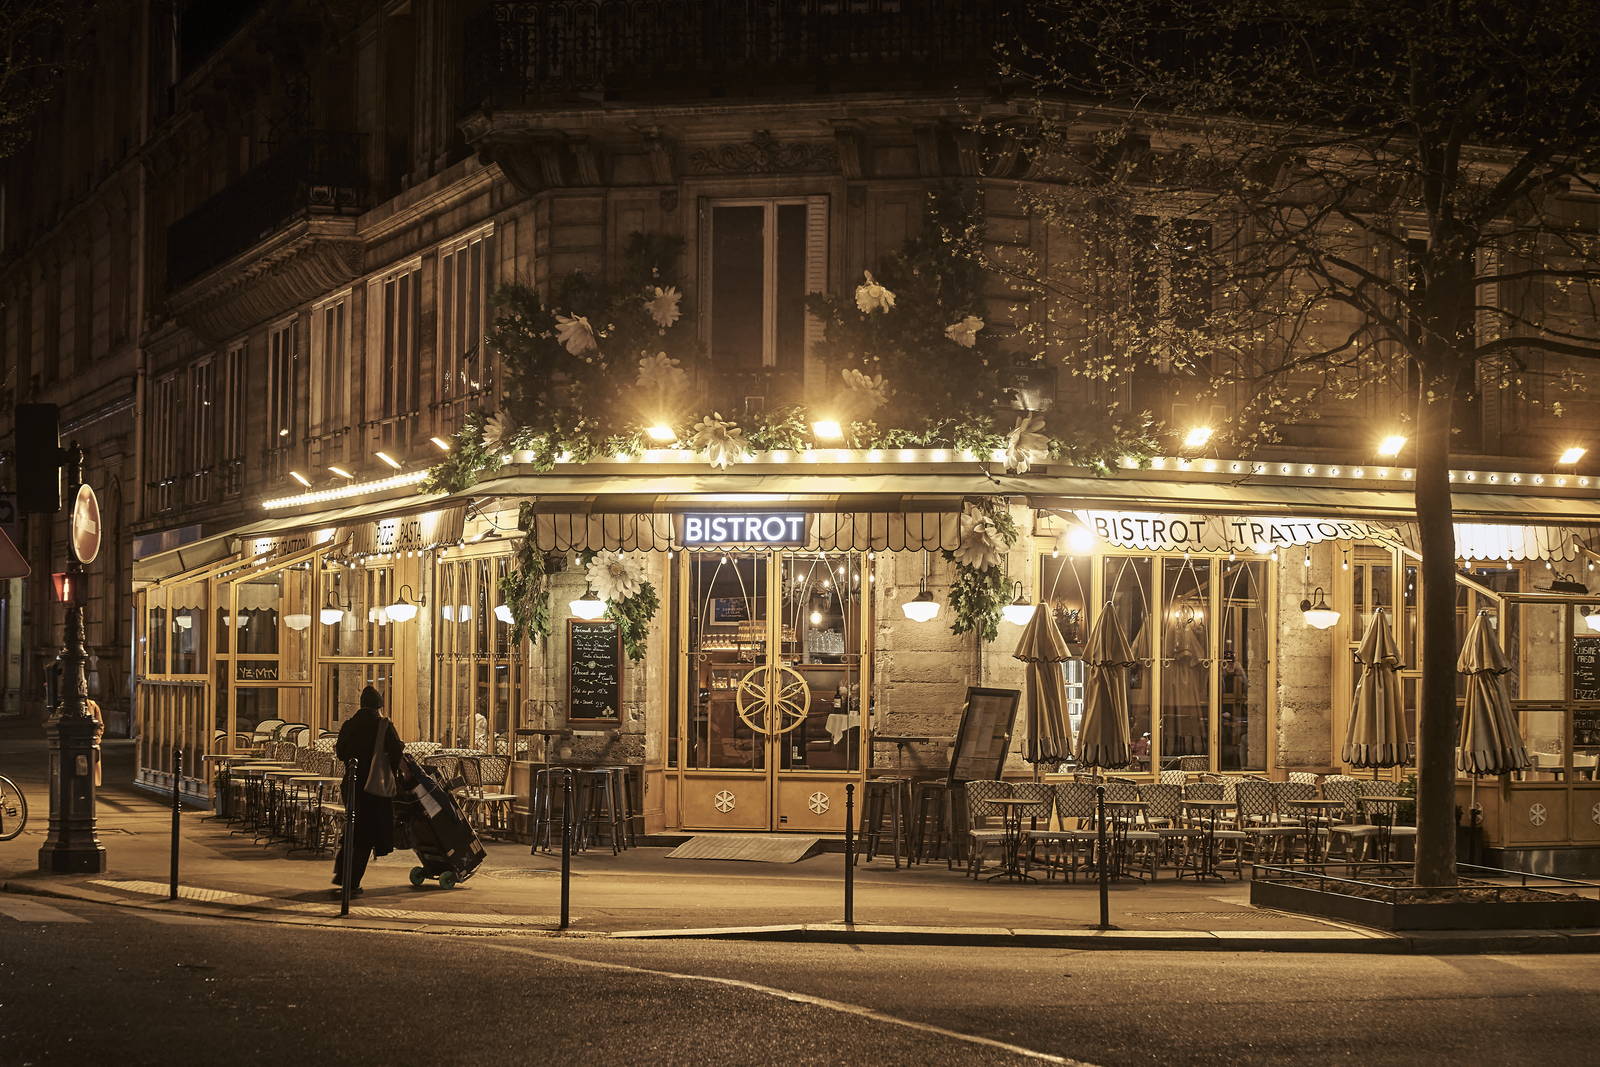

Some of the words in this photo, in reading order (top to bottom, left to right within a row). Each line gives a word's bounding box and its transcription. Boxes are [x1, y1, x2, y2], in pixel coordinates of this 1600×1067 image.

[685, 516, 804, 541] BISTROT
[1095, 517, 1206, 544] BISTROT
[1231, 522, 1386, 545] TRATTORIA
